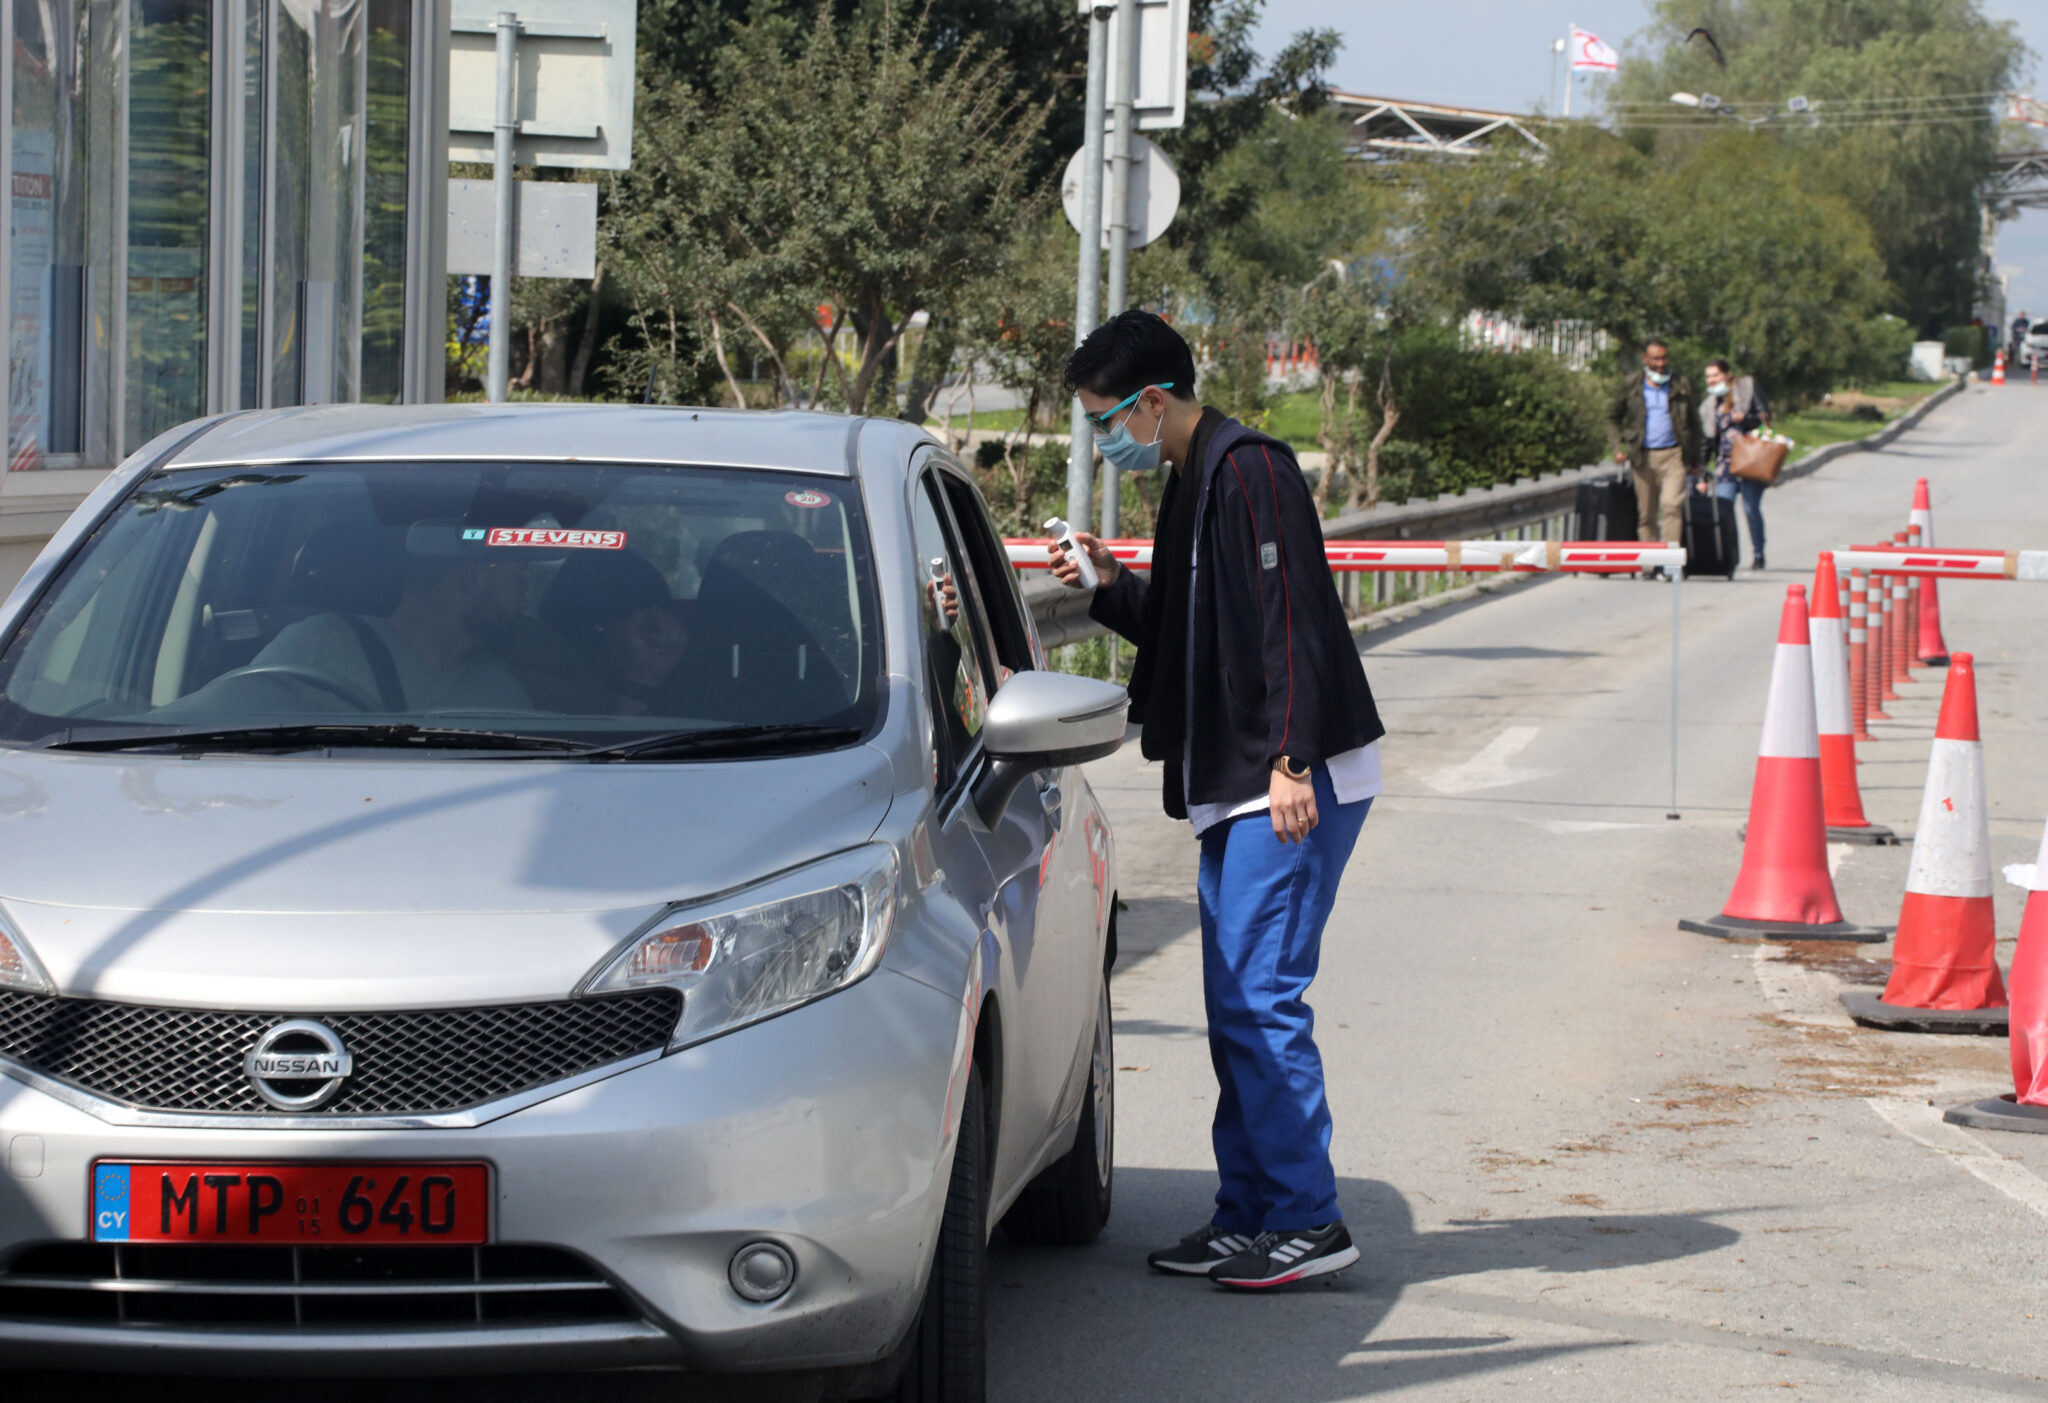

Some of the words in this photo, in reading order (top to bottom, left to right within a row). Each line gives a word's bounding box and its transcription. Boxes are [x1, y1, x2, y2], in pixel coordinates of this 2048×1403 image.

[497, 530, 618, 546] STEVENS
[254, 1060, 339, 1073] NISSAN
[160, 1174, 284, 1234] MTP
[338, 1174, 455, 1235] 640
[98, 1212, 126, 1229] CY
[297, 1218, 321, 1235] 15
